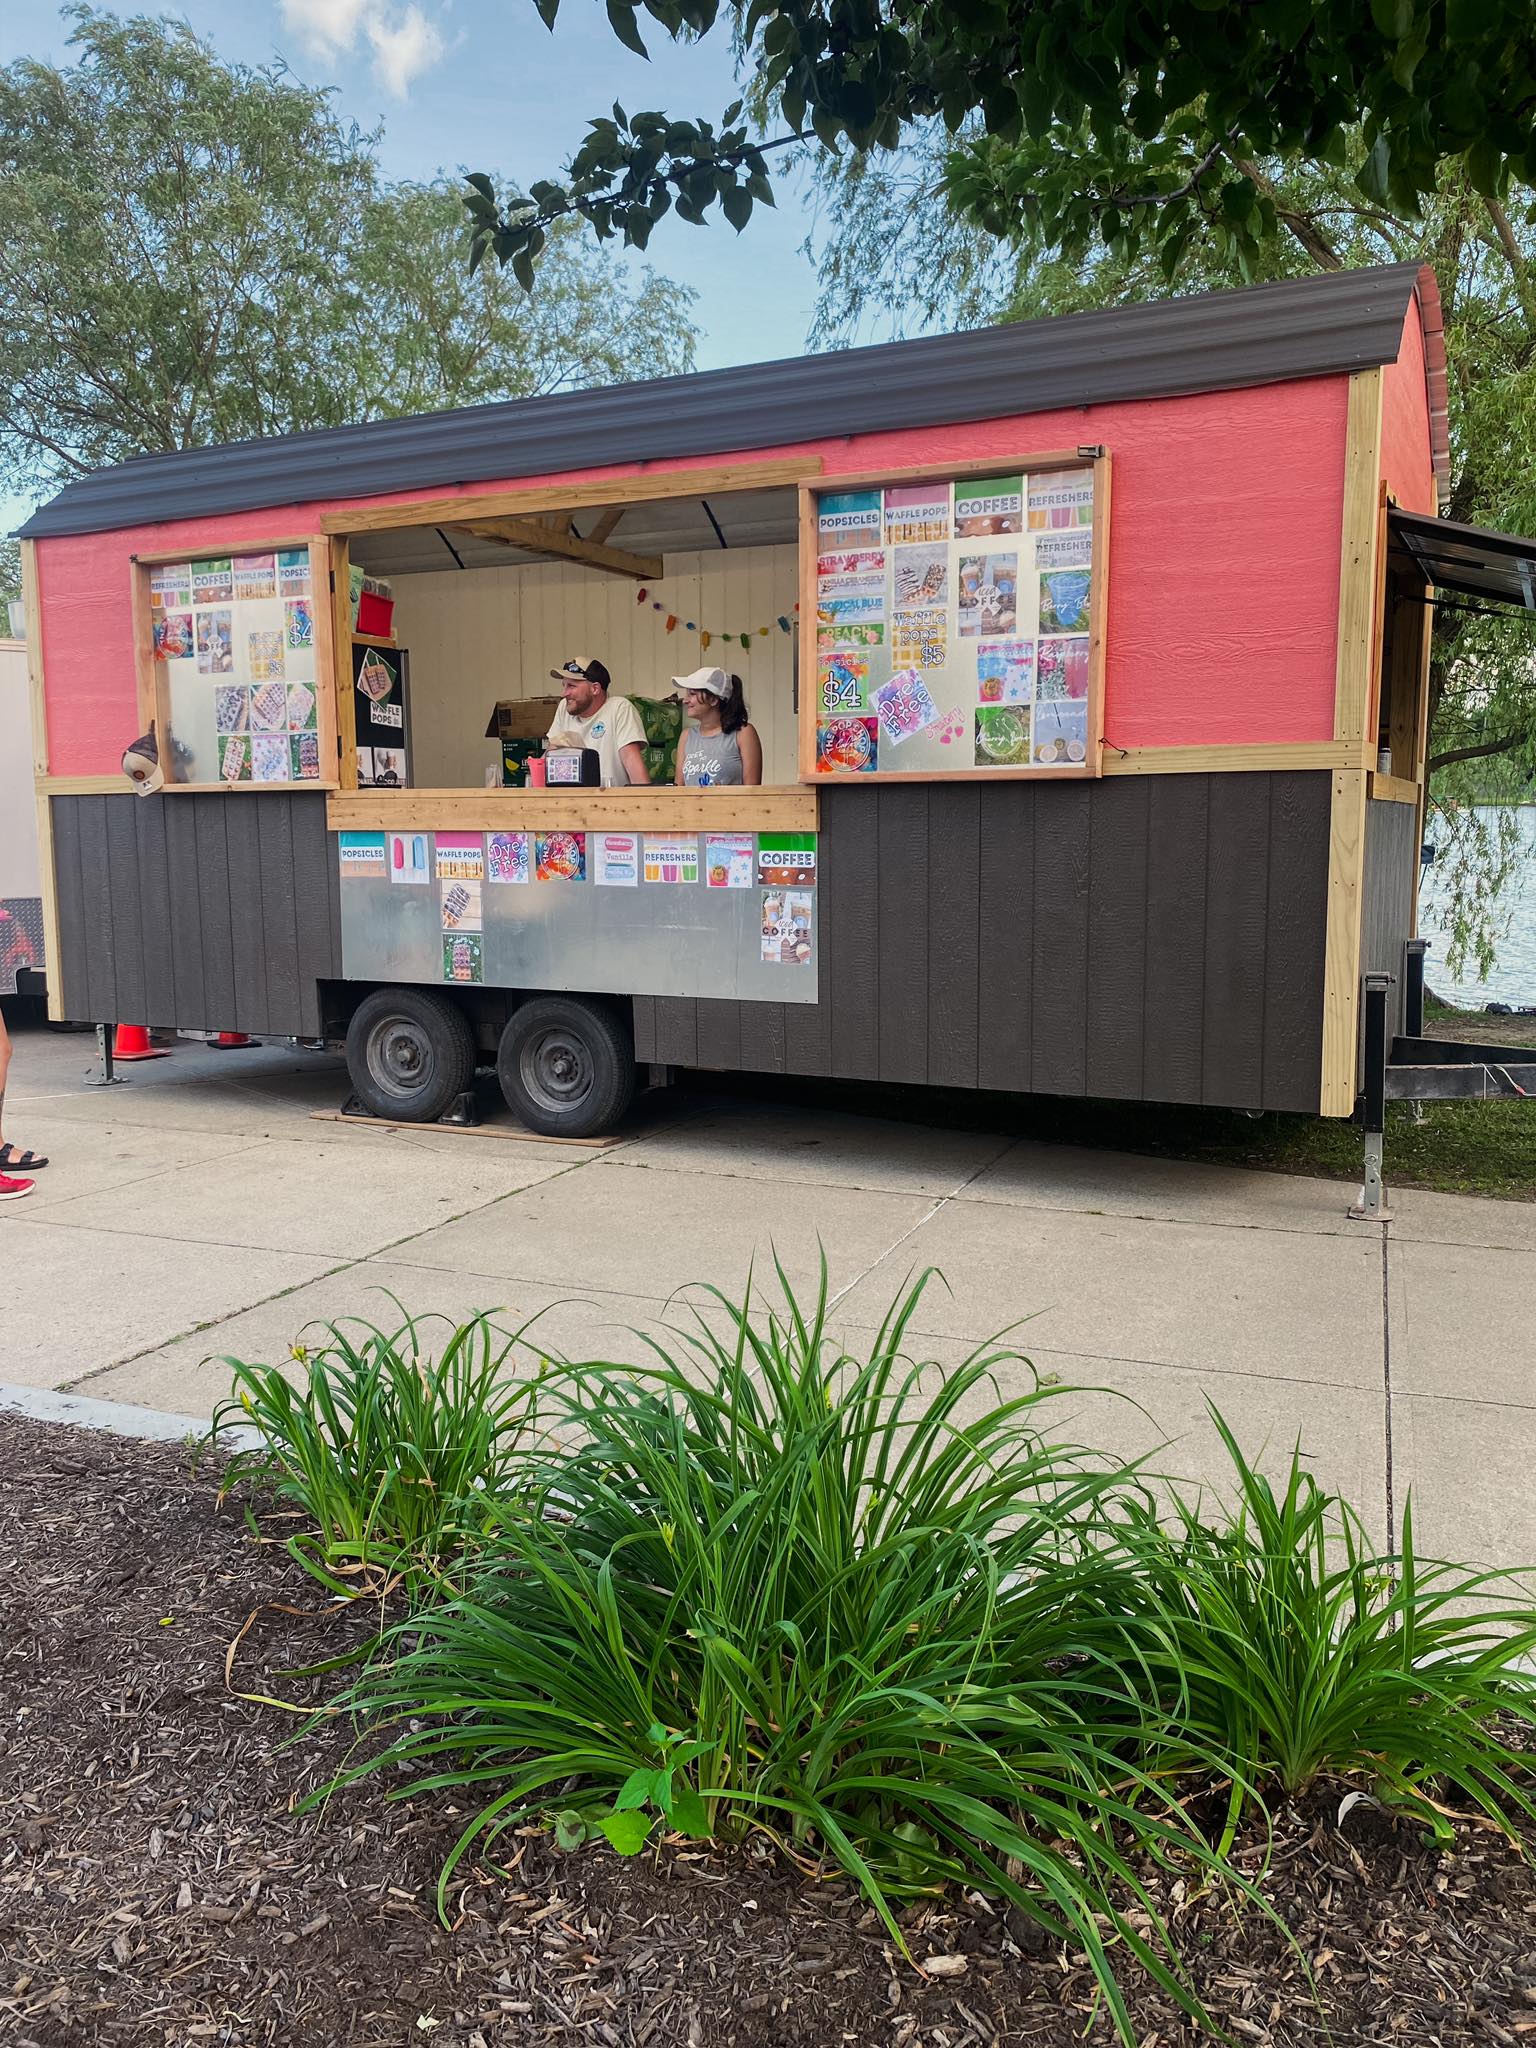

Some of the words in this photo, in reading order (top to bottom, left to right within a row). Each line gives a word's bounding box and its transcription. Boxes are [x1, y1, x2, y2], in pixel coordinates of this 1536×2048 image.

[958, 496, 1018, 515] COFFEE
[1029, 490, 1093, 506] REFRESHERS
[820, 513, 879, 528] POPSICLES
[886, 508, 921, 521] WAFFLE
[922, 506, 947, 517] POPS
[819, 551, 885, 566] STRAWBERRY
[194, 573, 230, 586] COFFEE
[235, 572, 257, 580] WAFFLE
[258, 570, 274, 578] POPS
[817, 599, 861, 612] TROPICAL
[861, 598, 883, 608] BLUE
[893, 610, 945, 627] Waffle
[288, 614, 313, 648] $4
[827, 625, 872, 639] PEACH
[900, 628, 938, 646] pops
[921, 640, 945, 669] $5
[823, 670, 862, 712] $4
[880, 682, 914, 718] Dye
[371, 703, 400, 716] WFLE
[886, 689, 929, 738] Free
[372, 713, 393, 724] POPS
[825, 732, 835, 755] THE
[832, 720, 852, 733] POP
[683, 759, 721, 779] Sparkle
[342, 849, 384, 858] POPSICLES
[437, 850, 462, 859] WAFFLE
[463, 851, 481, 859] POPS
[490, 841, 521, 860] Dye
[542, 844, 550, 864] THE
[548, 835, 564, 844] POP
[645, 853, 697, 862] REFRESHERS
[761, 852, 812, 866] COFFEE
[490, 854, 529, 877] Free
[762, 926, 808, 938] COFFEE
